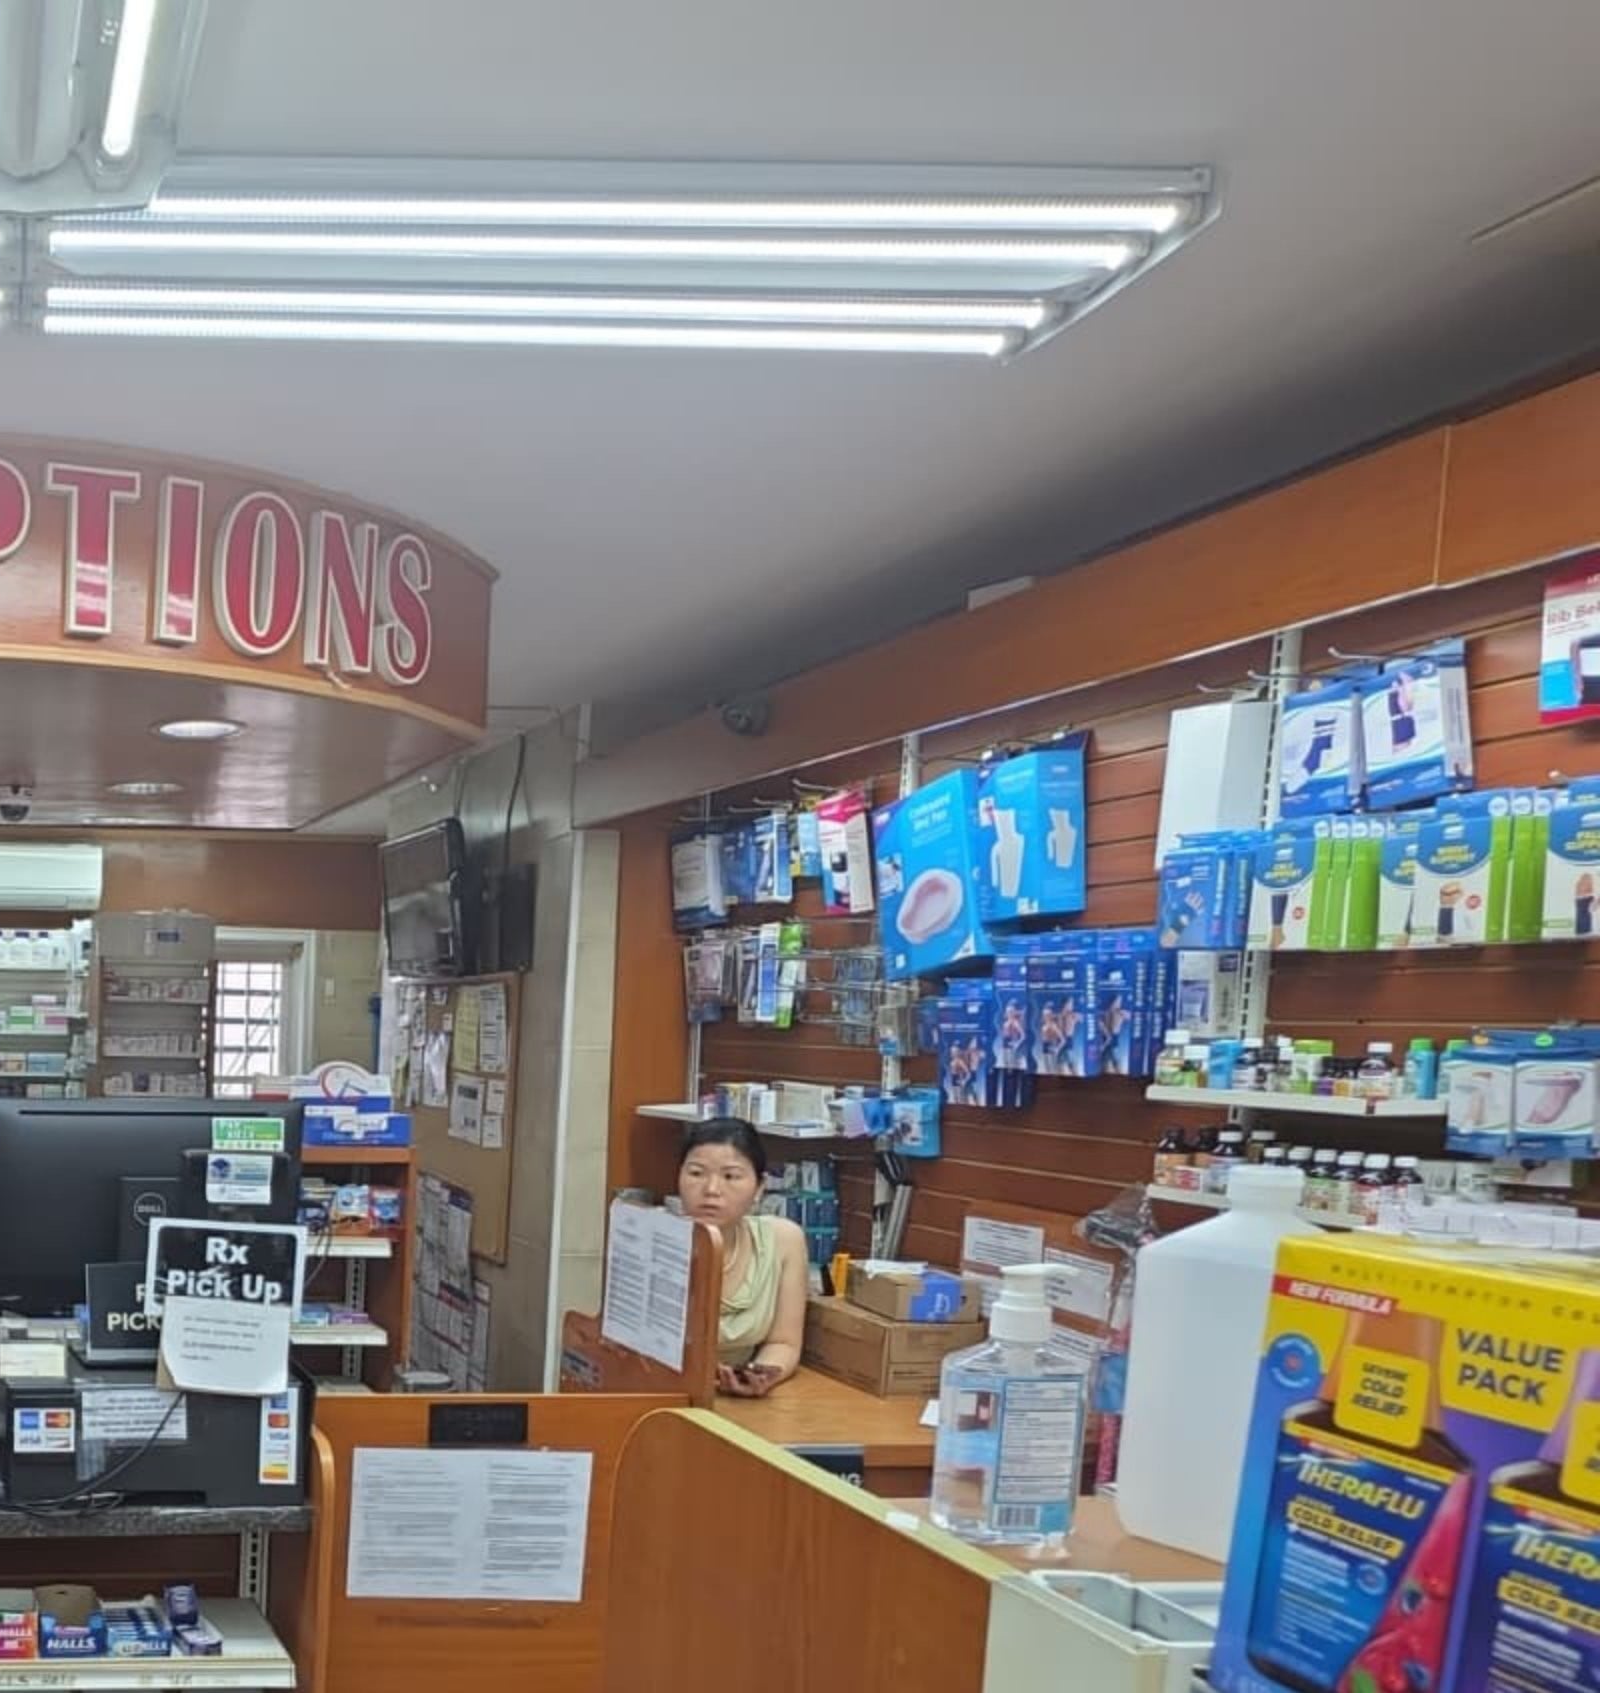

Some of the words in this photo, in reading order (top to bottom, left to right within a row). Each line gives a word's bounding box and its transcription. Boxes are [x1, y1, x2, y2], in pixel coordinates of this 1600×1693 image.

[206, 1237, 249, 1265] Rx
[167, 1269, 232, 1297] Pick
[242, 1274, 282, 1305] Up
[1288, 1279, 1320, 1302] NEW
[1319, 1286, 1393, 1315] FORMULA
[1456, 1328, 1565, 1374] VALUE
[1362, 1362, 1408, 1382] SEVERE
[1458, 1363, 1548, 1406] PACK
[1361, 1377, 1406, 1400] COLD
[1353, 1393, 1408, 1418] RELIEF
[1297, 1453, 1426, 1520] THERAFLU
[1293, 1506, 1331, 1530] COLD
[1336, 1520, 1397, 1552] RELIEF
[1507, 1584, 1559, 1613] COLD
[46, 1636, 97, 1650] HALLS
